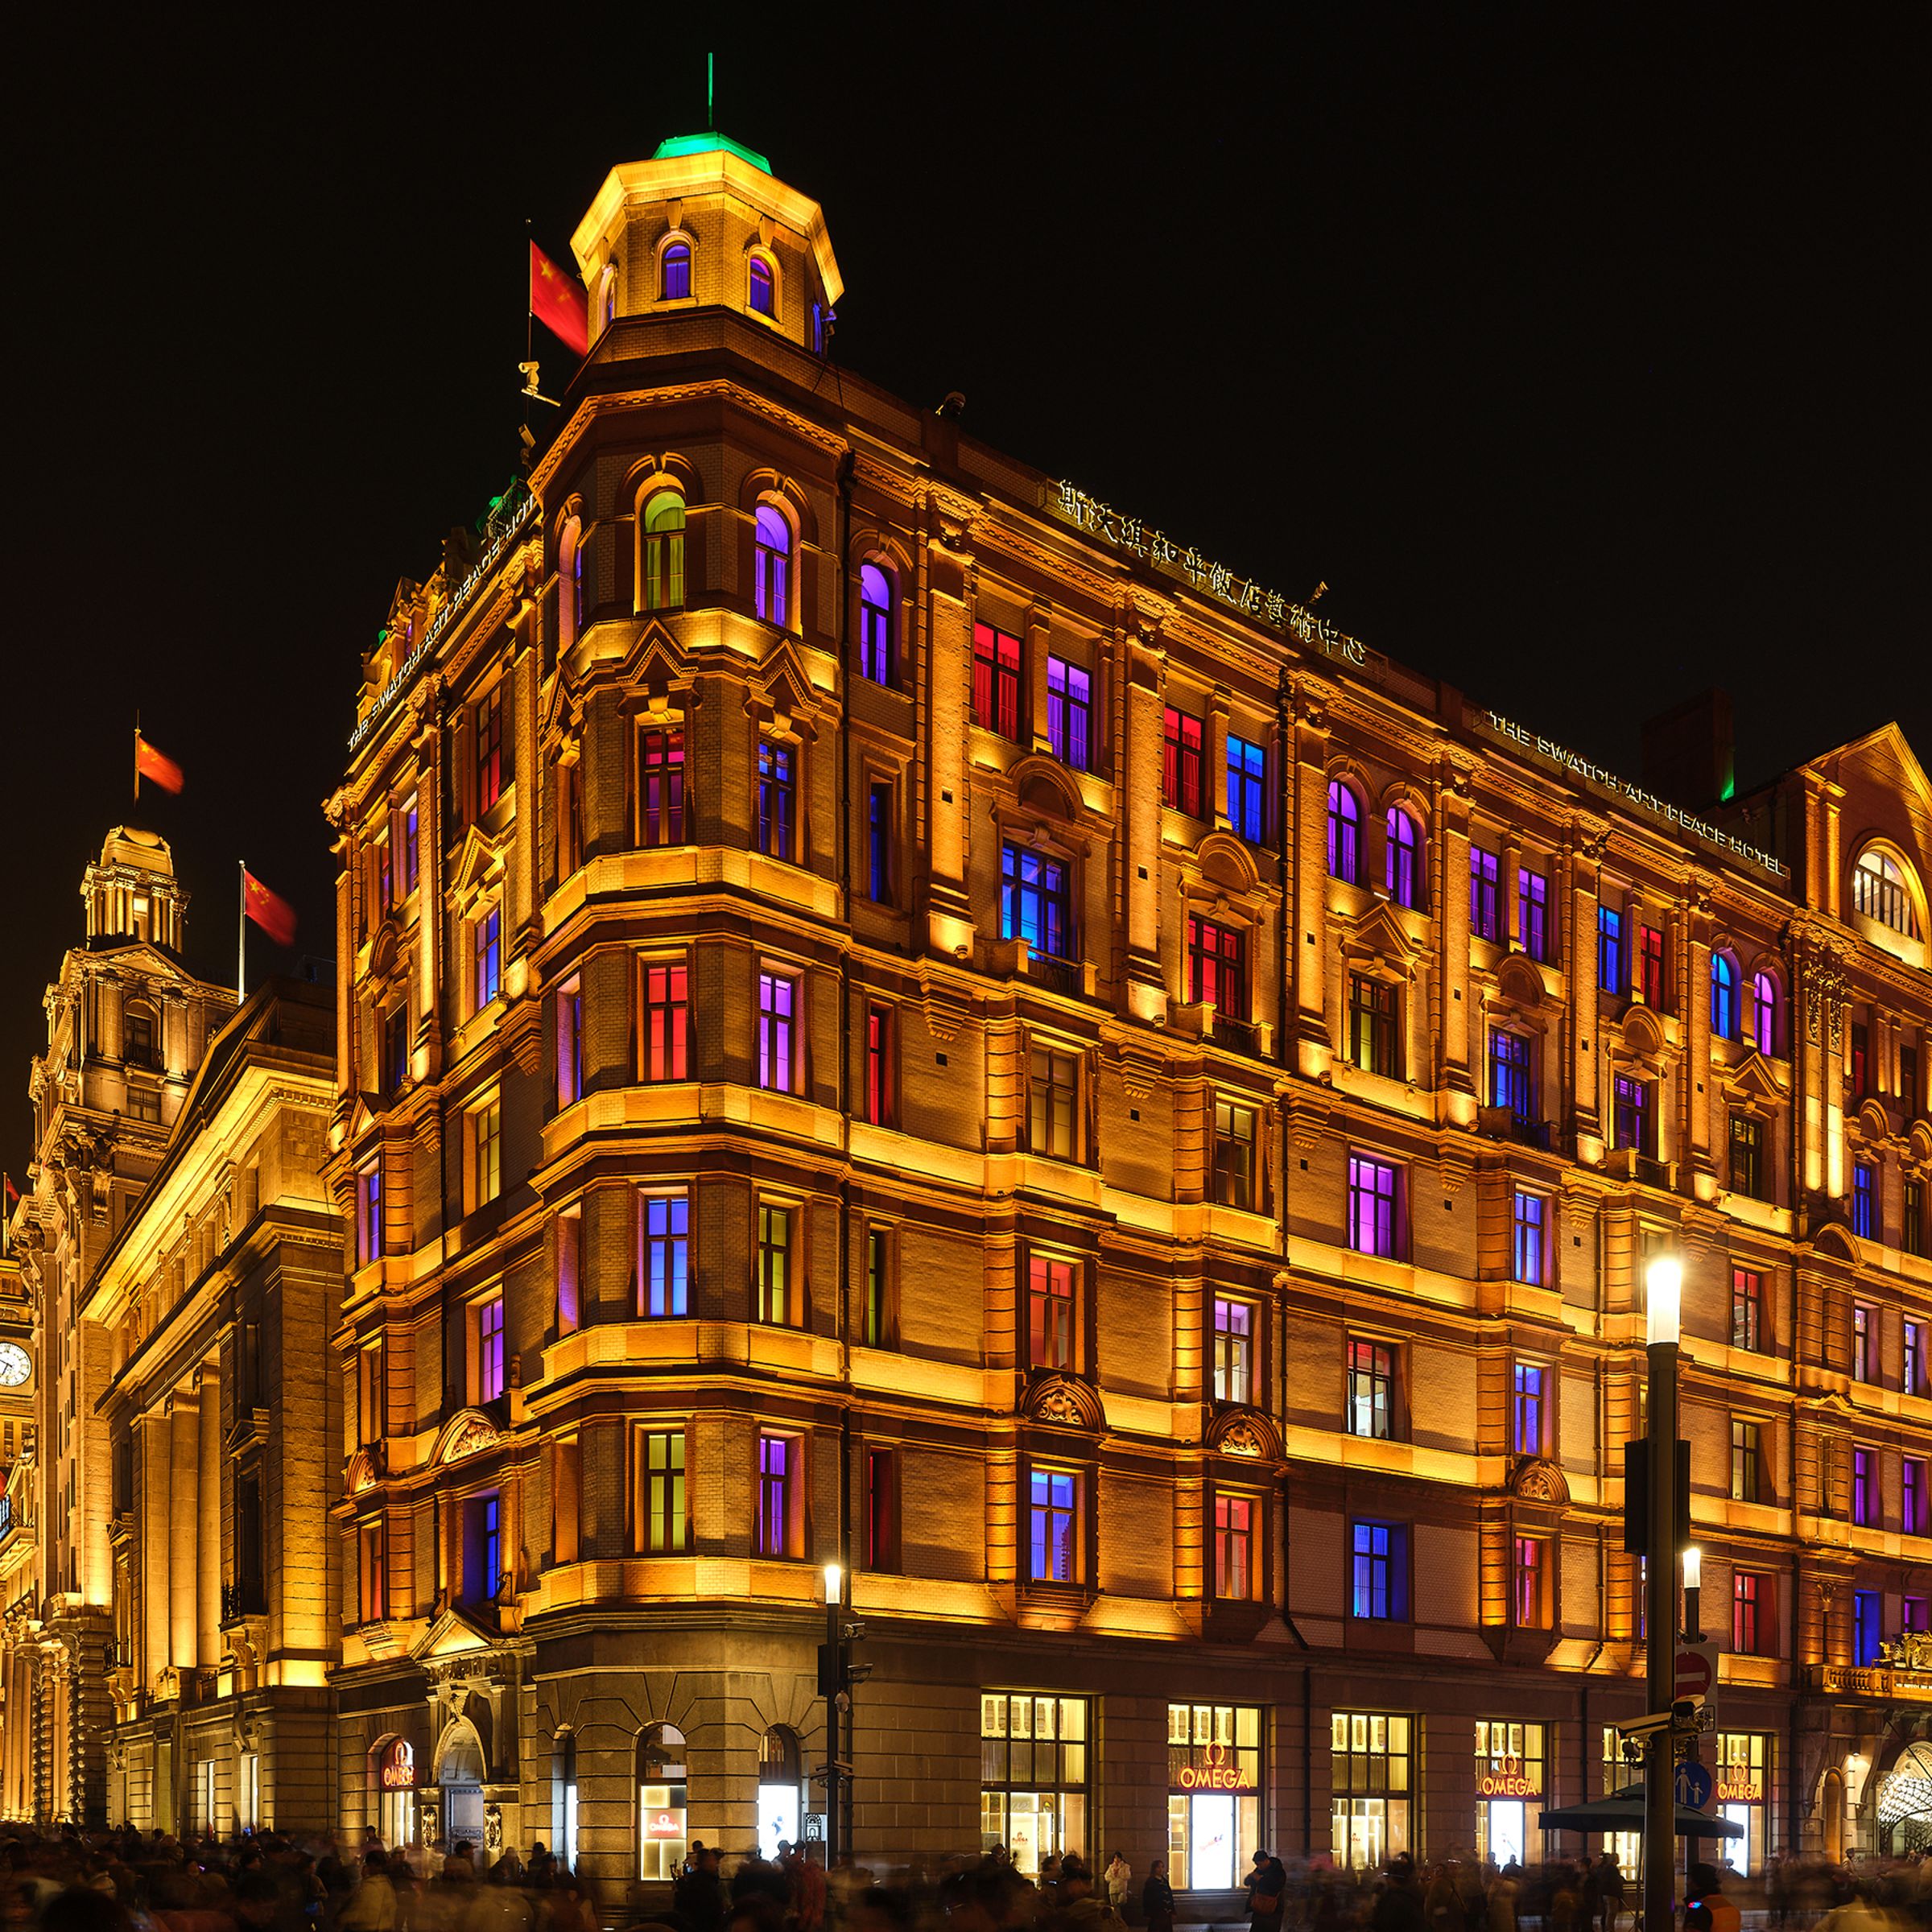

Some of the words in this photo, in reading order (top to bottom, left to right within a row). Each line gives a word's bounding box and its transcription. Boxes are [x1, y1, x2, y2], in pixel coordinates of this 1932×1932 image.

[347, 719, 369, 753] THE
[372, 643, 420, 716] SWATCH
[423, 603, 450, 653] ART
[453, 536, 501, 612] PEACE
[1489, 711, 1530, 747] THE
[1537, 736, 1620, 793] SWATCH
[1625, 782, 1663, 814] ART
[1666, 803, 1726, 848] PEACE
[1729, 836, 1786, 877] HOTEL
[383, 1767, 415, 1786] OMEGA
[1179, 1767, 1251, 1790] OMEGA
[1481, 1777, 1538, 1797] OMEGA
[1717, 1783, 1762, 1800] OMEGA
